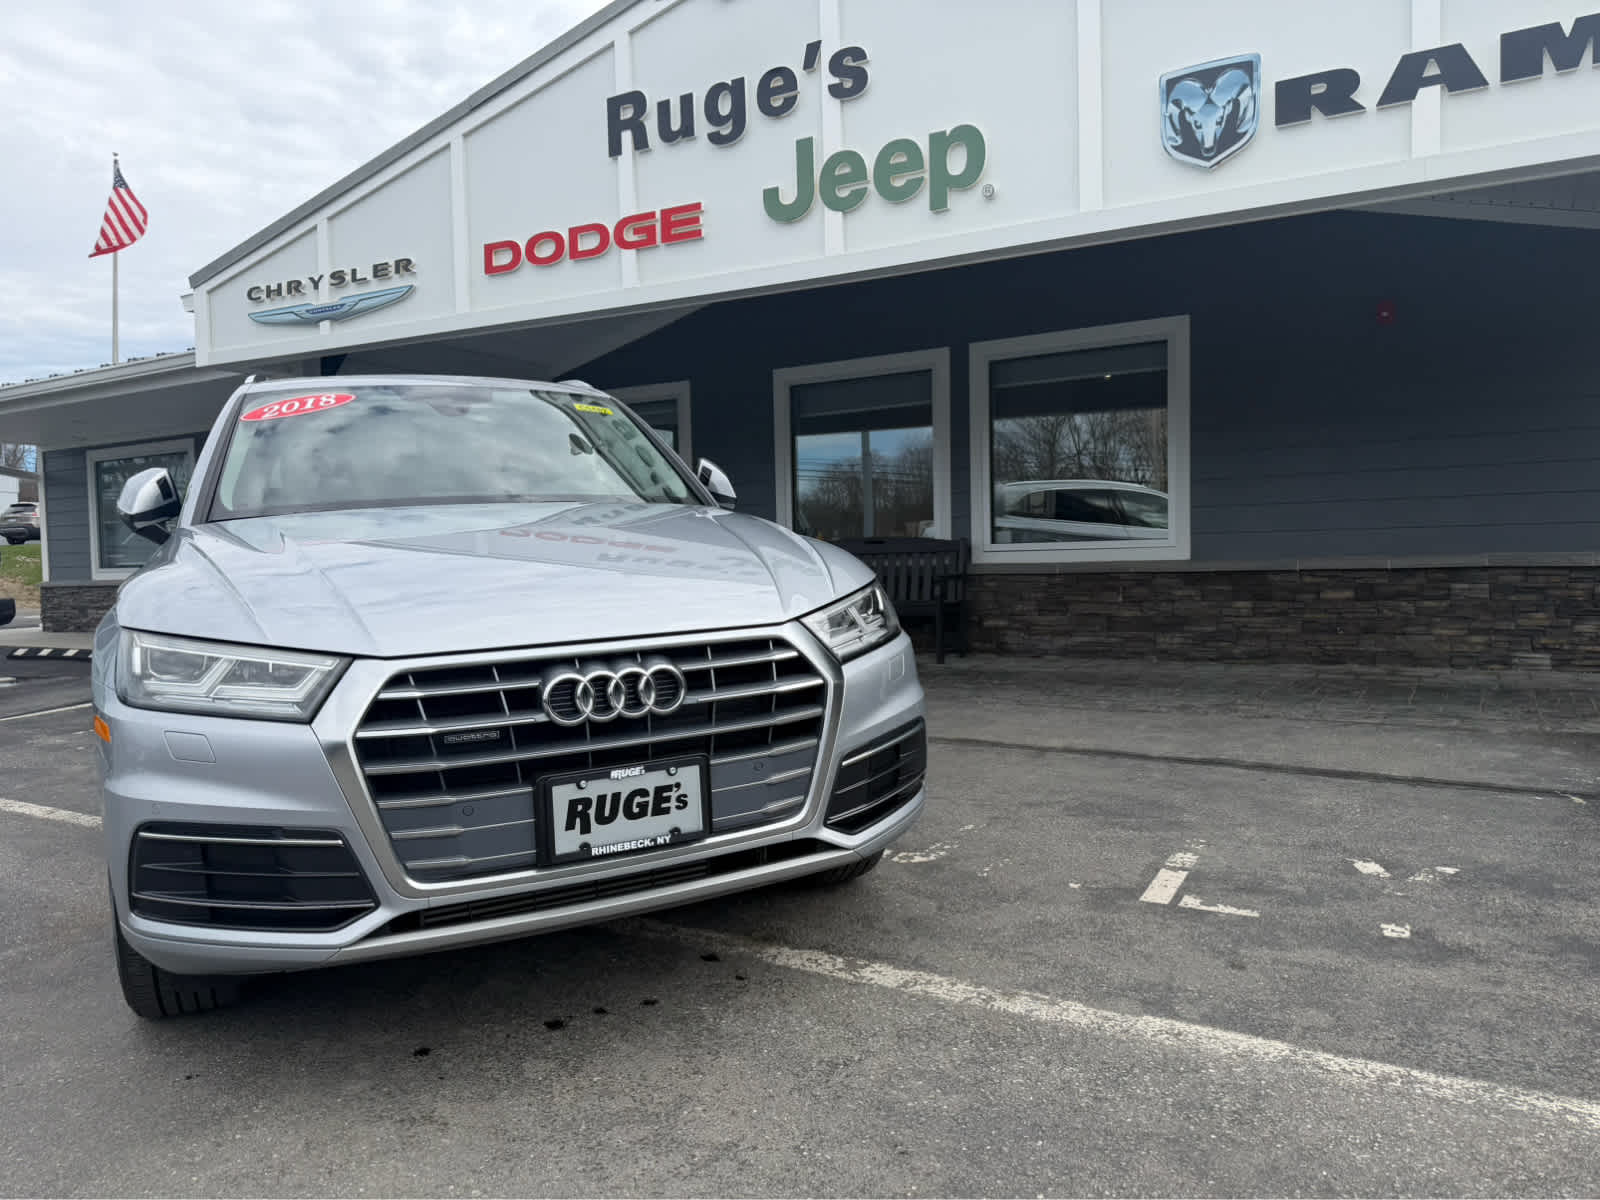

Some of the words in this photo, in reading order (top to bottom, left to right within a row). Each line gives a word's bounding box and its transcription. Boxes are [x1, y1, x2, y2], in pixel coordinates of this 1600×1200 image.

[606, 39, 869, 159] Ruge's
[1274, 12, 1600, 128] RAM
[762, 124, 987, 224] Jeep
[483, 201, 704, 276] DODGE
[246, 257, 416, 302] CHRYSLER
[263, 393, 337, 418] 2018
[564, 781, 689, 836] RUGE's
[656, 834, 672, 846] NY
